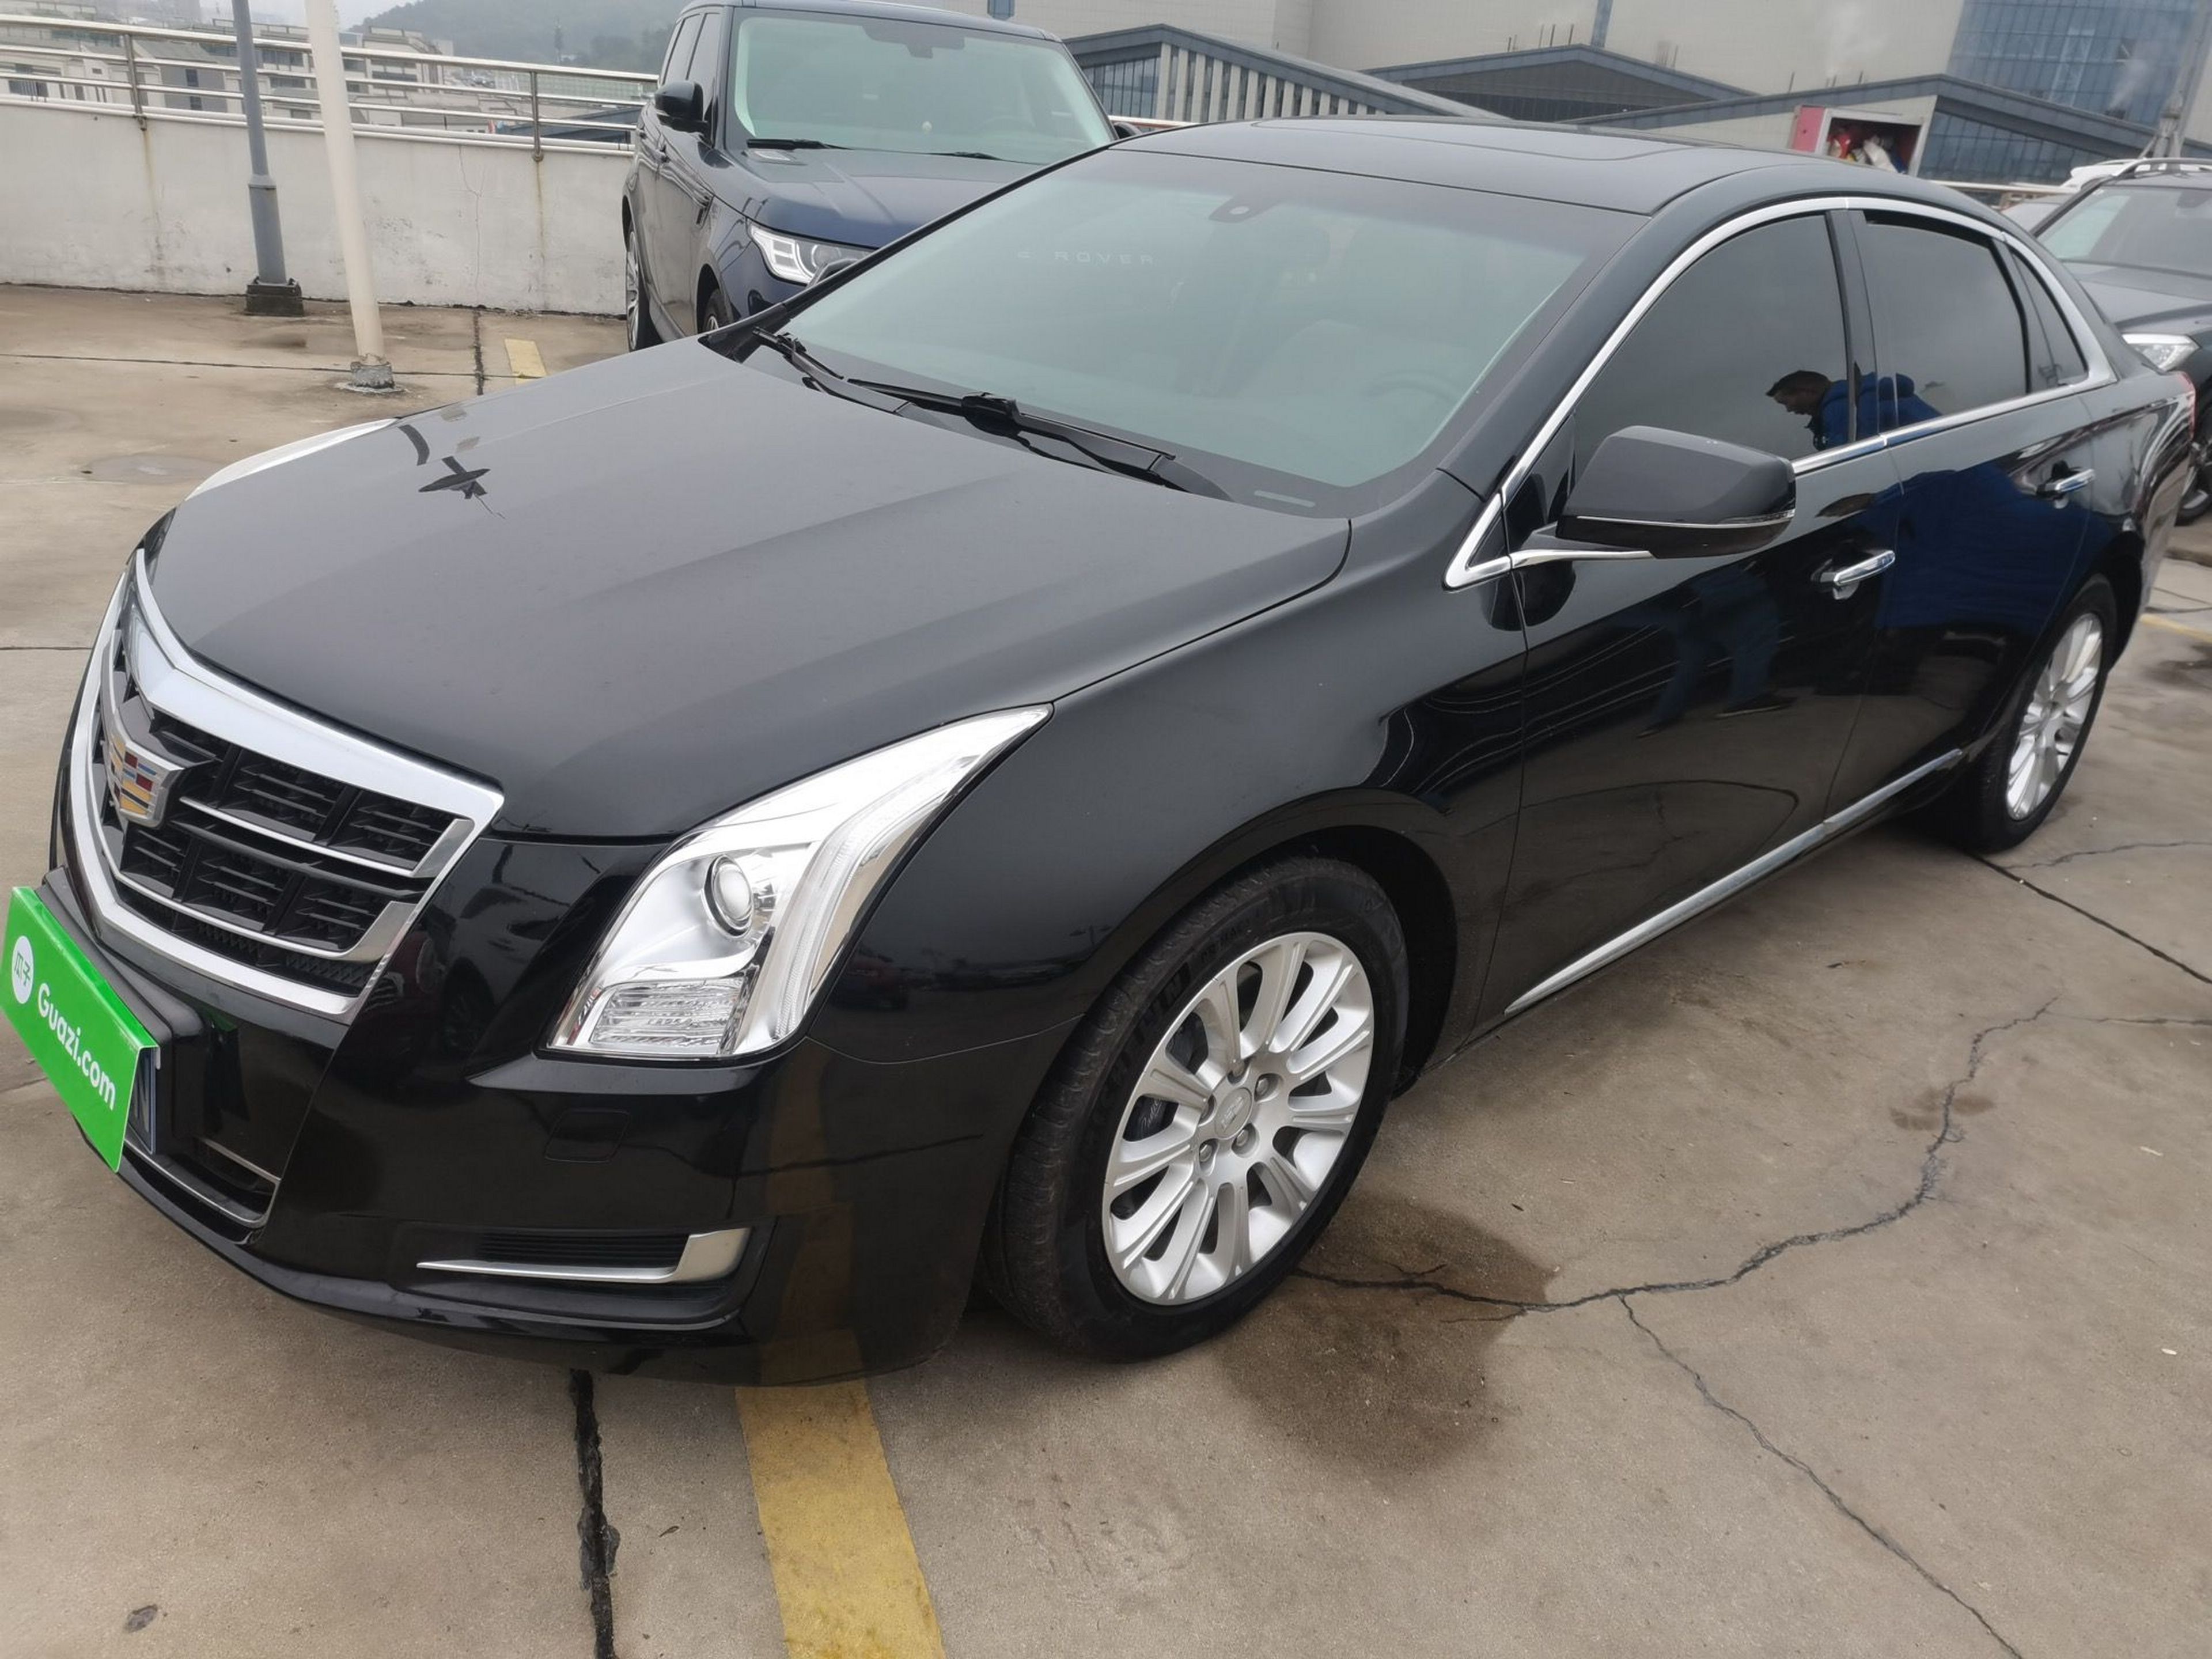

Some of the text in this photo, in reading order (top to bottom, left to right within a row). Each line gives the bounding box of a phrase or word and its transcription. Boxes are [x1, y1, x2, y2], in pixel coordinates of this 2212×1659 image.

[1054, 250, 1153, 264] ROVER
[14, 951, 31, 987] 瓜子
[37, 983, 116, 1111] Guazi.com
